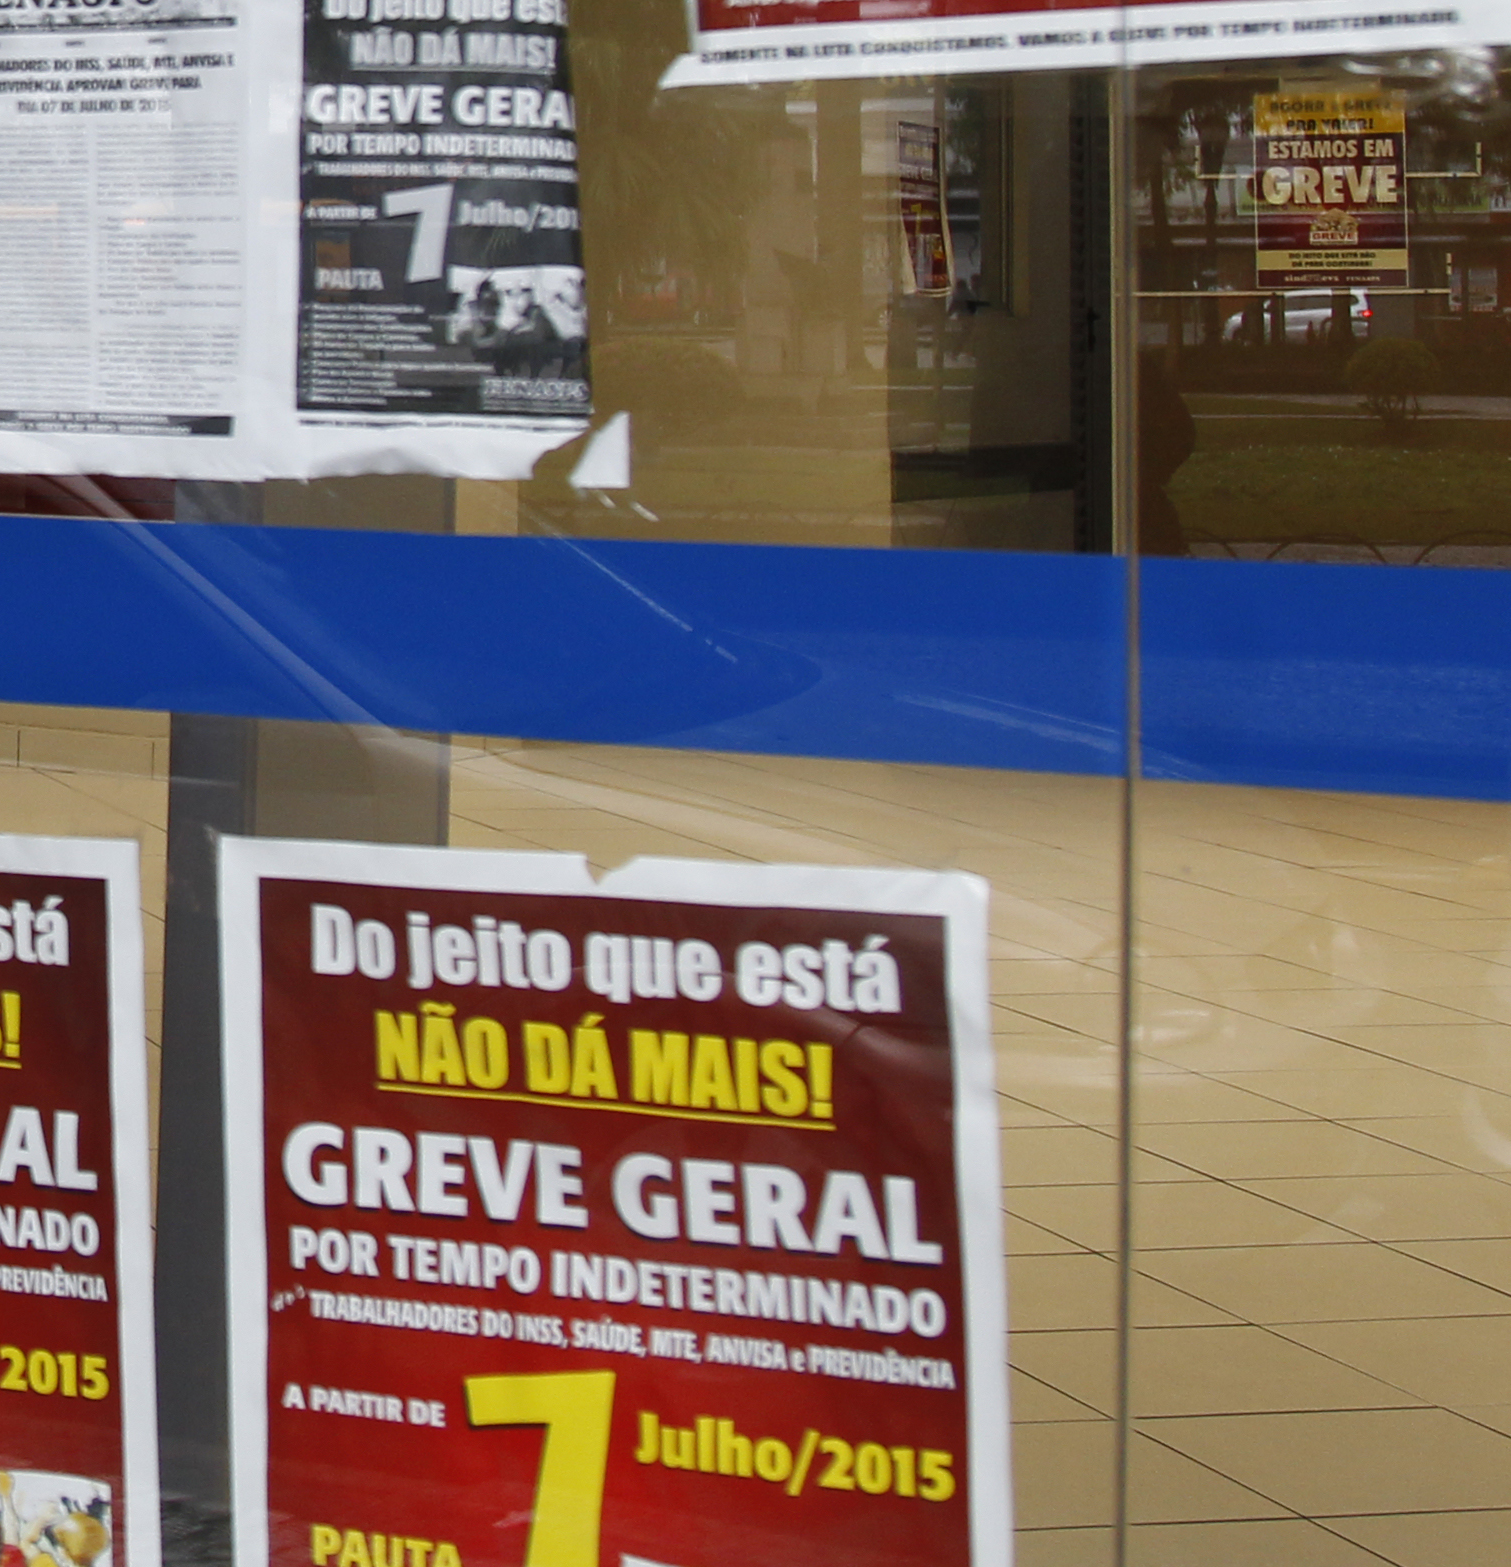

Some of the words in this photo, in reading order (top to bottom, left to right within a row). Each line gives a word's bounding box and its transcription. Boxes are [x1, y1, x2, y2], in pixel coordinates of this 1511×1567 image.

[1268, 140, 1357, 159] ESTAMOS
[1364, 139, 1393, 157] EM
[1262, 165, 1397, 205] GREVE
[281, 1123, 588, 1227] GREVE
[612, 1154, 942, 1263] GERAL
